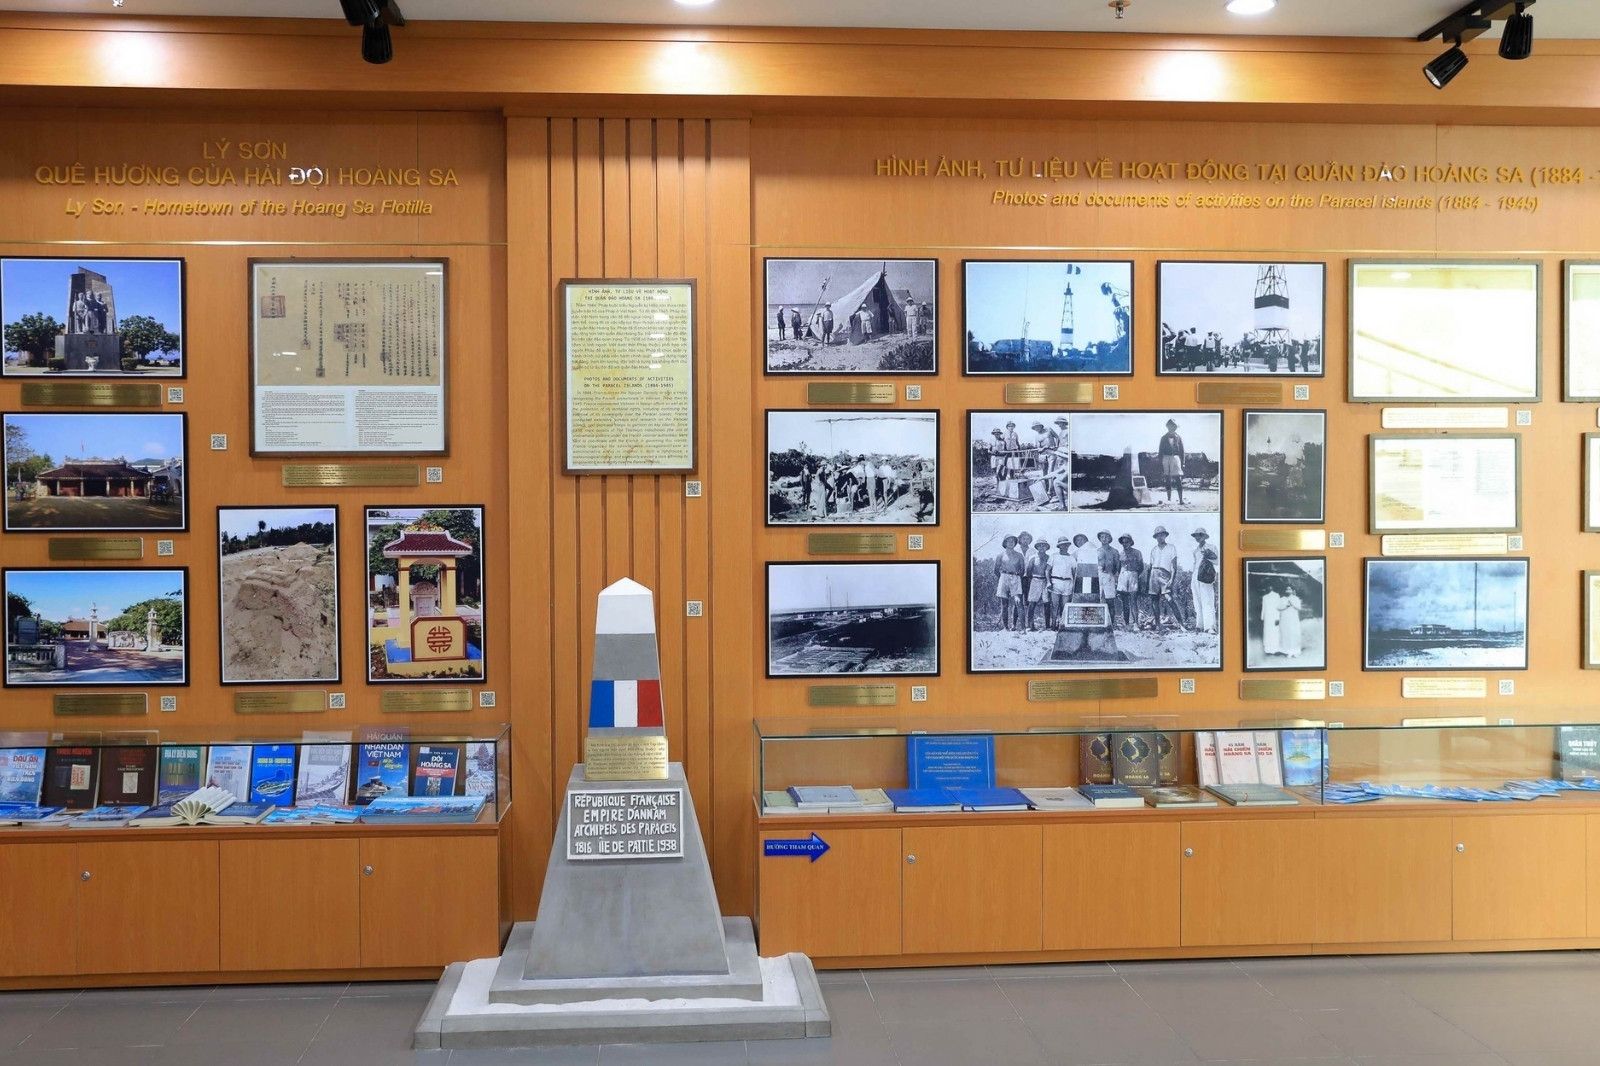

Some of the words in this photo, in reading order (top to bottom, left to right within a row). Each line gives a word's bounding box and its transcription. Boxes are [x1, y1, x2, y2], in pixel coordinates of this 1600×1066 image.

[239, 139, 287, 160] SƠN
[35, 162, 86, 184] QUÊ
[94, 163, 180, 185] HƯƠNG
[188, 163, 236, 185] CỦA
[244, 164, 281, 185] HẢI
[289, 165, 329, 190] ĐỘI
[429, 168, 459, 186] SA
[875, 154, 929, 177] HÌNH
[936, 154, 987, 180] ẢNH,
[996, 157, 1024, 178] TƯ
[1032, 156, 1079, 182] LIỆU
[1086, 157, 1114, 179] VỀ
[1121, 162, 1180, 183] HOẠT
[1186, 159, 1248, 183] ĐỘNG
[1258, 163, 1289, 184] TẠI
[1296, 160, 1354, 182] QUẦN
[1362, 161, 1406, 183] ĐẢO
[1414, 162, 1488, 183] HOÀNG
[1497, 166, 1523, 183] SA
[1531, 166, 1585, 187] (1884
[65, 198, 86, 218] Ly
[92, 199, 124, 215] Son
[144, 199, 233, 216] Hometown
[240, 199, 256, 216] of
[261, 199, 286, 215] the
[293, 200, 347, 219] Hoang
[353, 200, 374, 215] Sa
[381, 200, 433, 215] Flotilla
[993, 190, 1047, 206] Photos
[1053, 191, 1081, 206] and
[1086, 191, 1169, 208] documents
[1176, 192, 1192, 208] of
[1196, 192, 1261, 209] activities
[1266, 195, 1285, 209] on
[1291, 194, 1313, 209] the
[1319, 194, 1376, 209] Paracel
[1438, 195, 1481, 212] (1884
[1499, 195, 1538, 212] 1945)
[367, 751, 383, 759] VIỆT
[583, 809, 624, 823] EMPIRE
[620, 822, 636, 835] DES
[575, 841, 592, 854] 1816
[612, 841, 625, 853] DE
[657, 840, 677, 852] 1938
